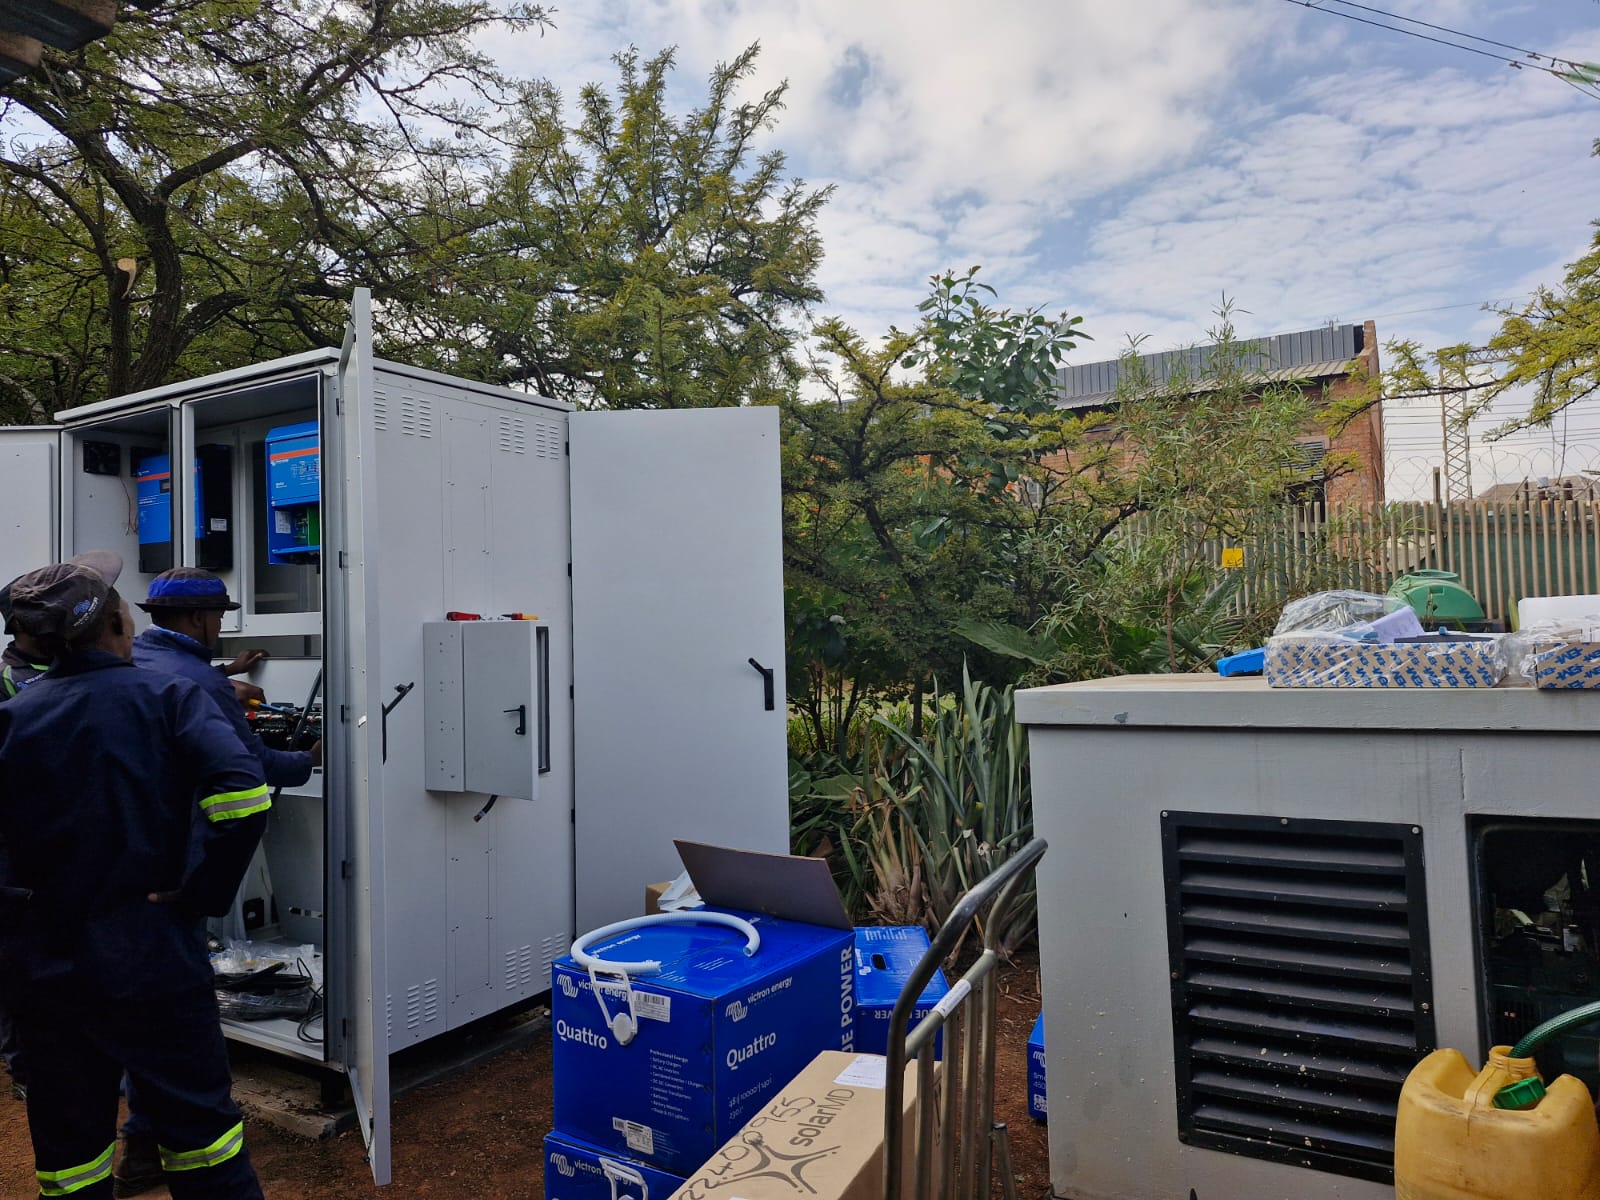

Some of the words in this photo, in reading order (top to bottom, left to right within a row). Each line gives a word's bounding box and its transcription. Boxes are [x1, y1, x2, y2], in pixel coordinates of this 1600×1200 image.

[747, 987, 770, 1004] victron
[771, 976, 793, 992] energy
[841, 945, 853, 1028] POWER
[556, 1019, 607, 1049] Quattro
[726, 1032, 776, 1070] Quattro
[789, 1088, 855, 1147] solarMD
[574, 1159, 602, 1175] victron
